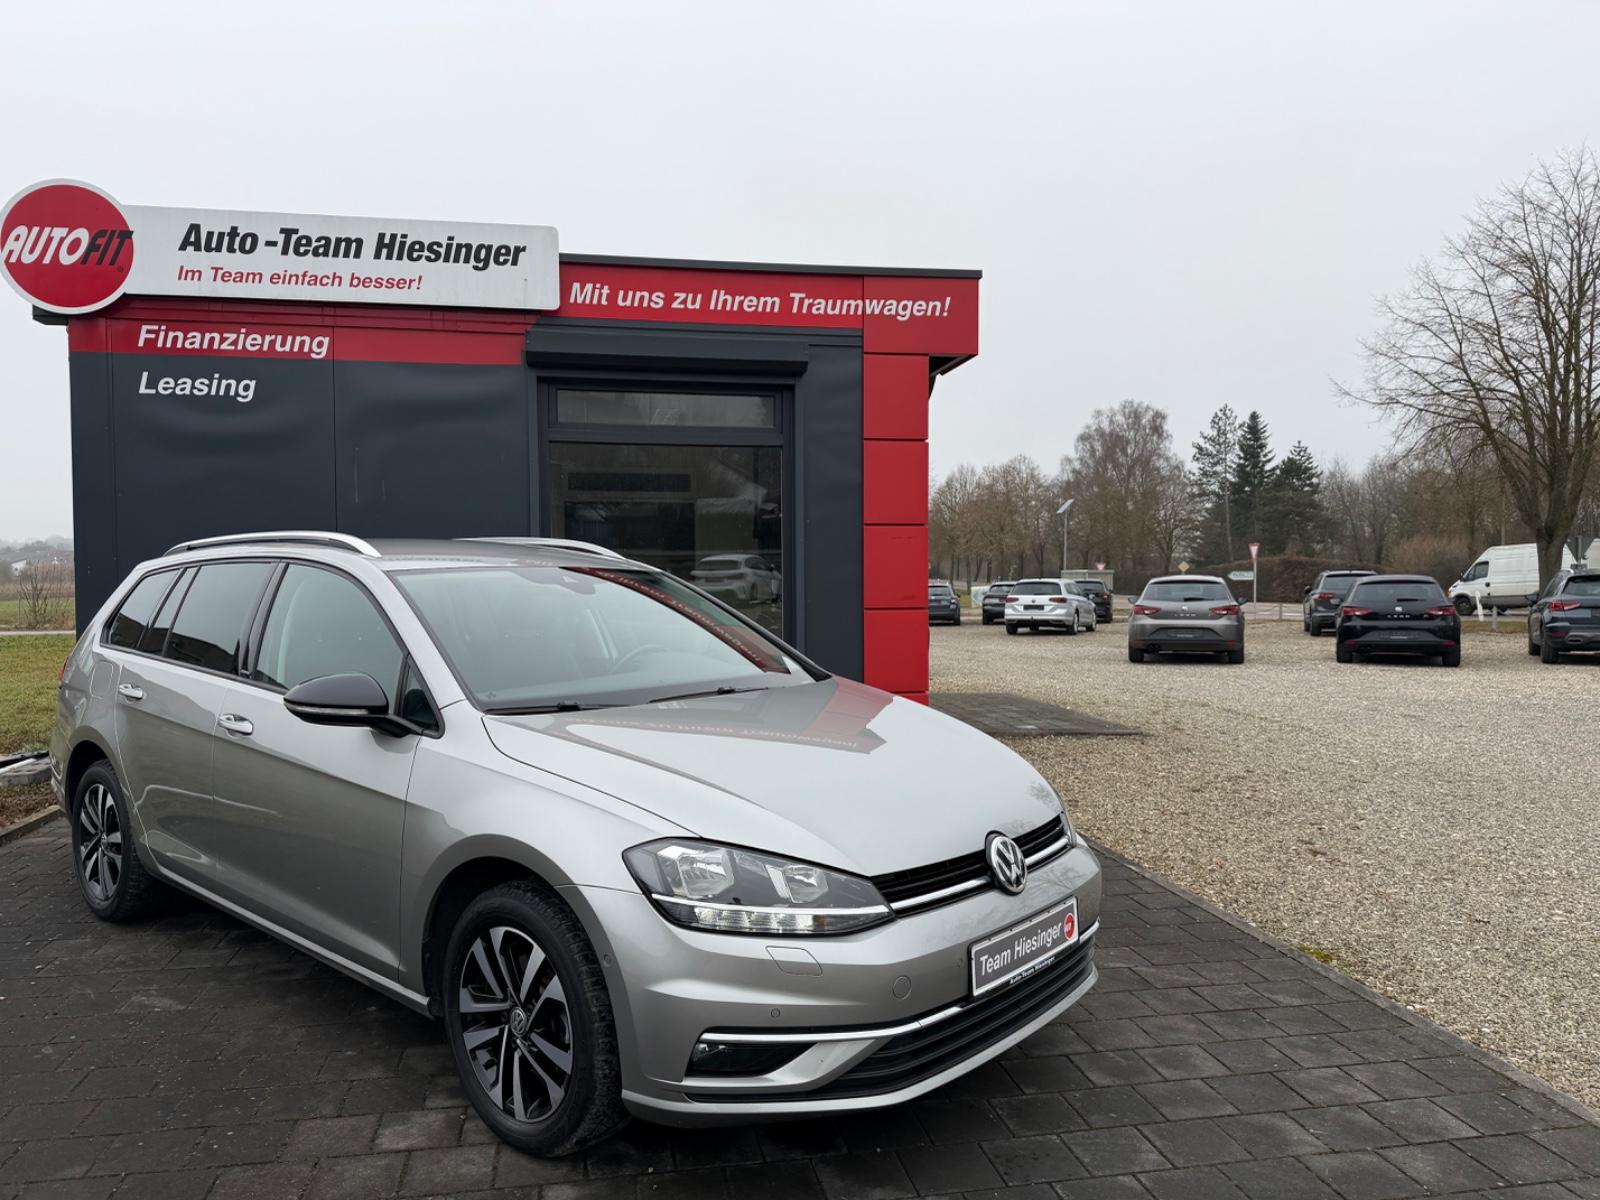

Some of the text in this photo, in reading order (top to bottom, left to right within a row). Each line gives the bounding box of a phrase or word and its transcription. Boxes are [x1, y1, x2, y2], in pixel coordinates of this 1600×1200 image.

[1, 225, 134, 266] AUTOFIT
[373, 233, 527, 272] Hiesinger
[177, 265, 423, 291] Im Team einfach besser!
[569, 282, 951, 322] Mit uns zu Ihrem Traumwagen!
[137, 324, 330, 360] Finanzierung
[138, 371, 257, 403] Leasing
[980, 922, 1062, 976] Team Hiesinger
